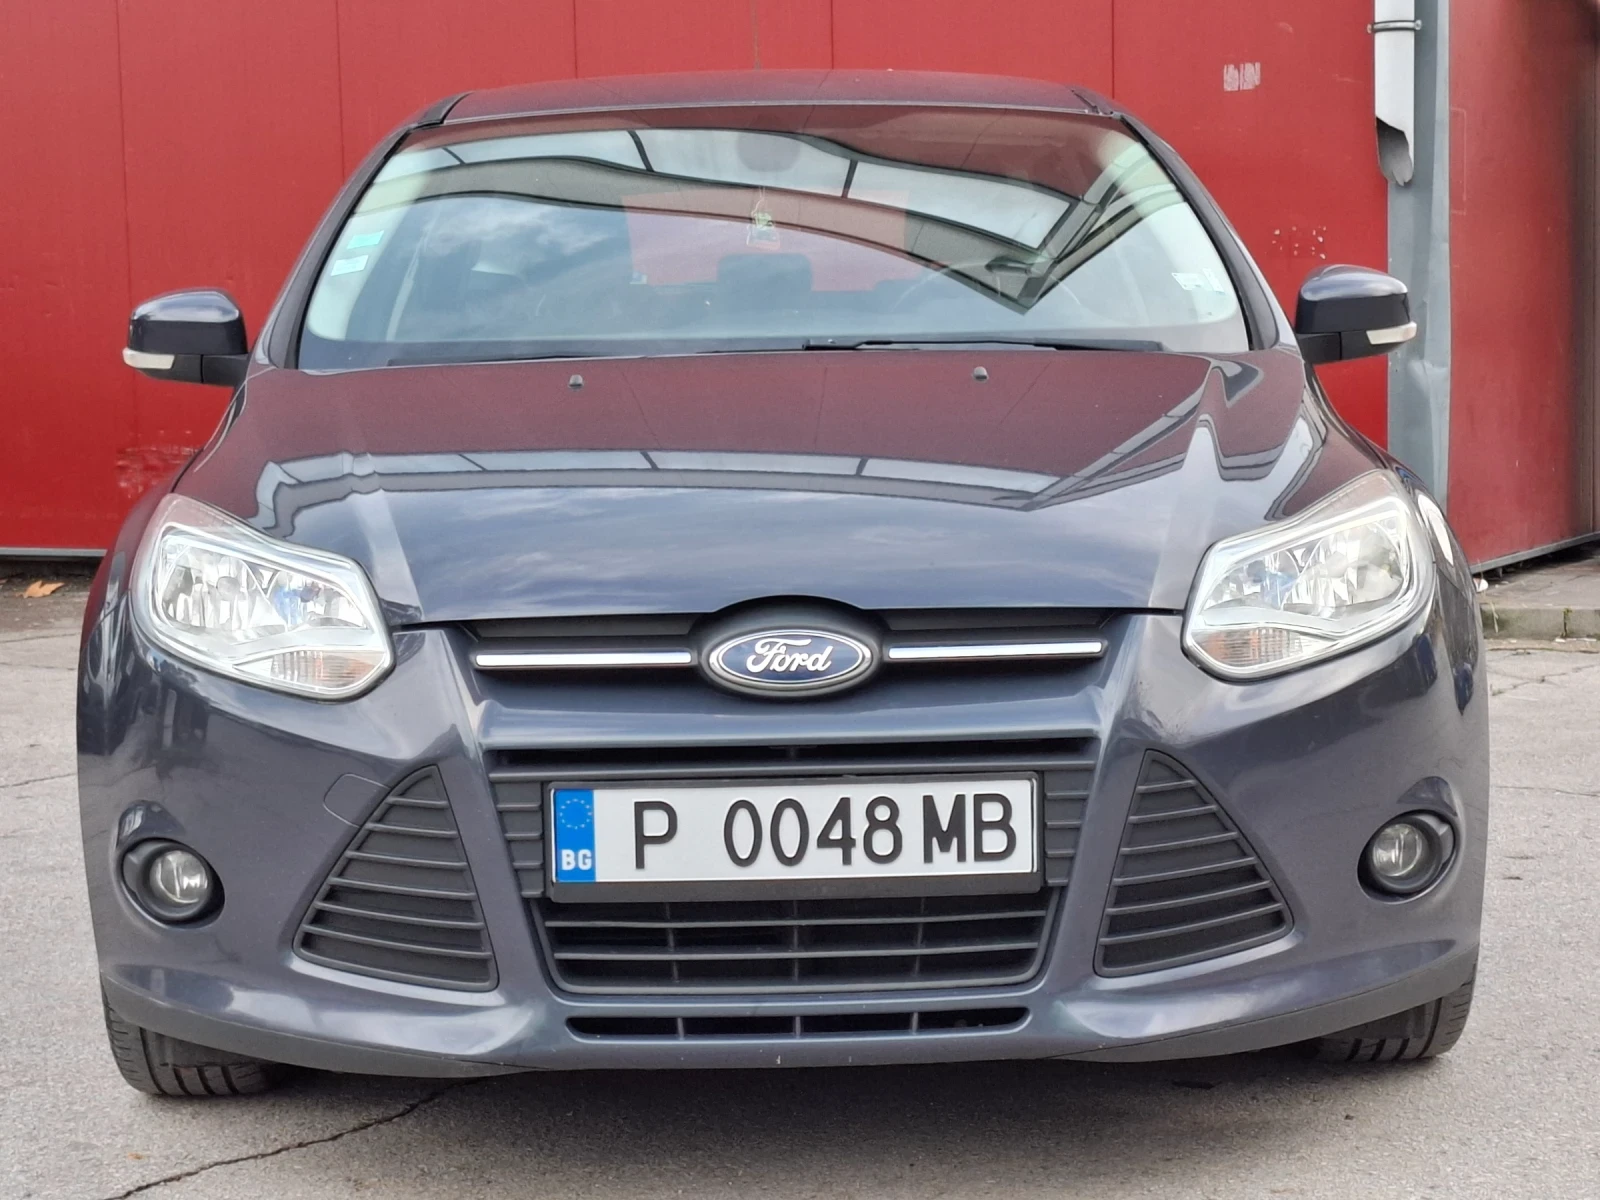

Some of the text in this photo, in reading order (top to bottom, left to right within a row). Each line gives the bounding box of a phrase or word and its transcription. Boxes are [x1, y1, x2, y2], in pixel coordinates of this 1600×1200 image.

[745, 637, 834, 673] Ford
[633, 793, 1017, 870] P 0048 MB
[561, 849, 592, 870] BG
